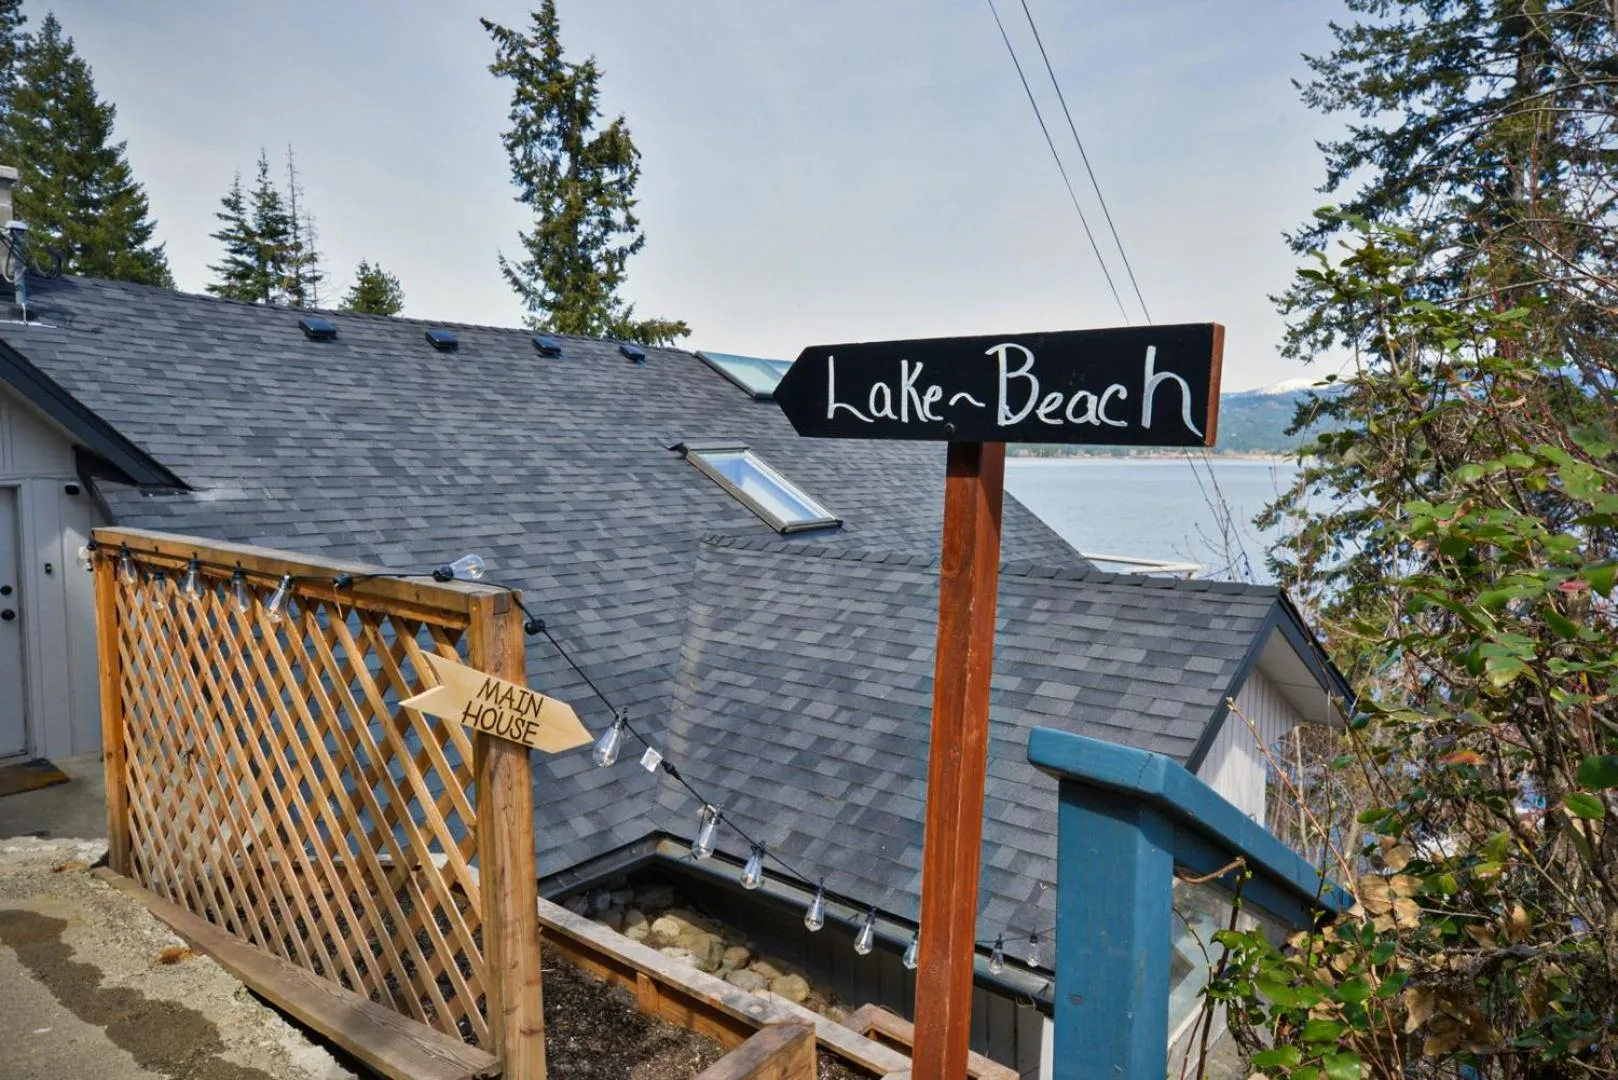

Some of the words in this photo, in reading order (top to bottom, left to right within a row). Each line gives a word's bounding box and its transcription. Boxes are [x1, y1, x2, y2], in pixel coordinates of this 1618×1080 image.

[985, 343, 1203, 437] Beach
[476, 678, 544, 718] MAIN
[461, 700, 540, 745] HOUSE
